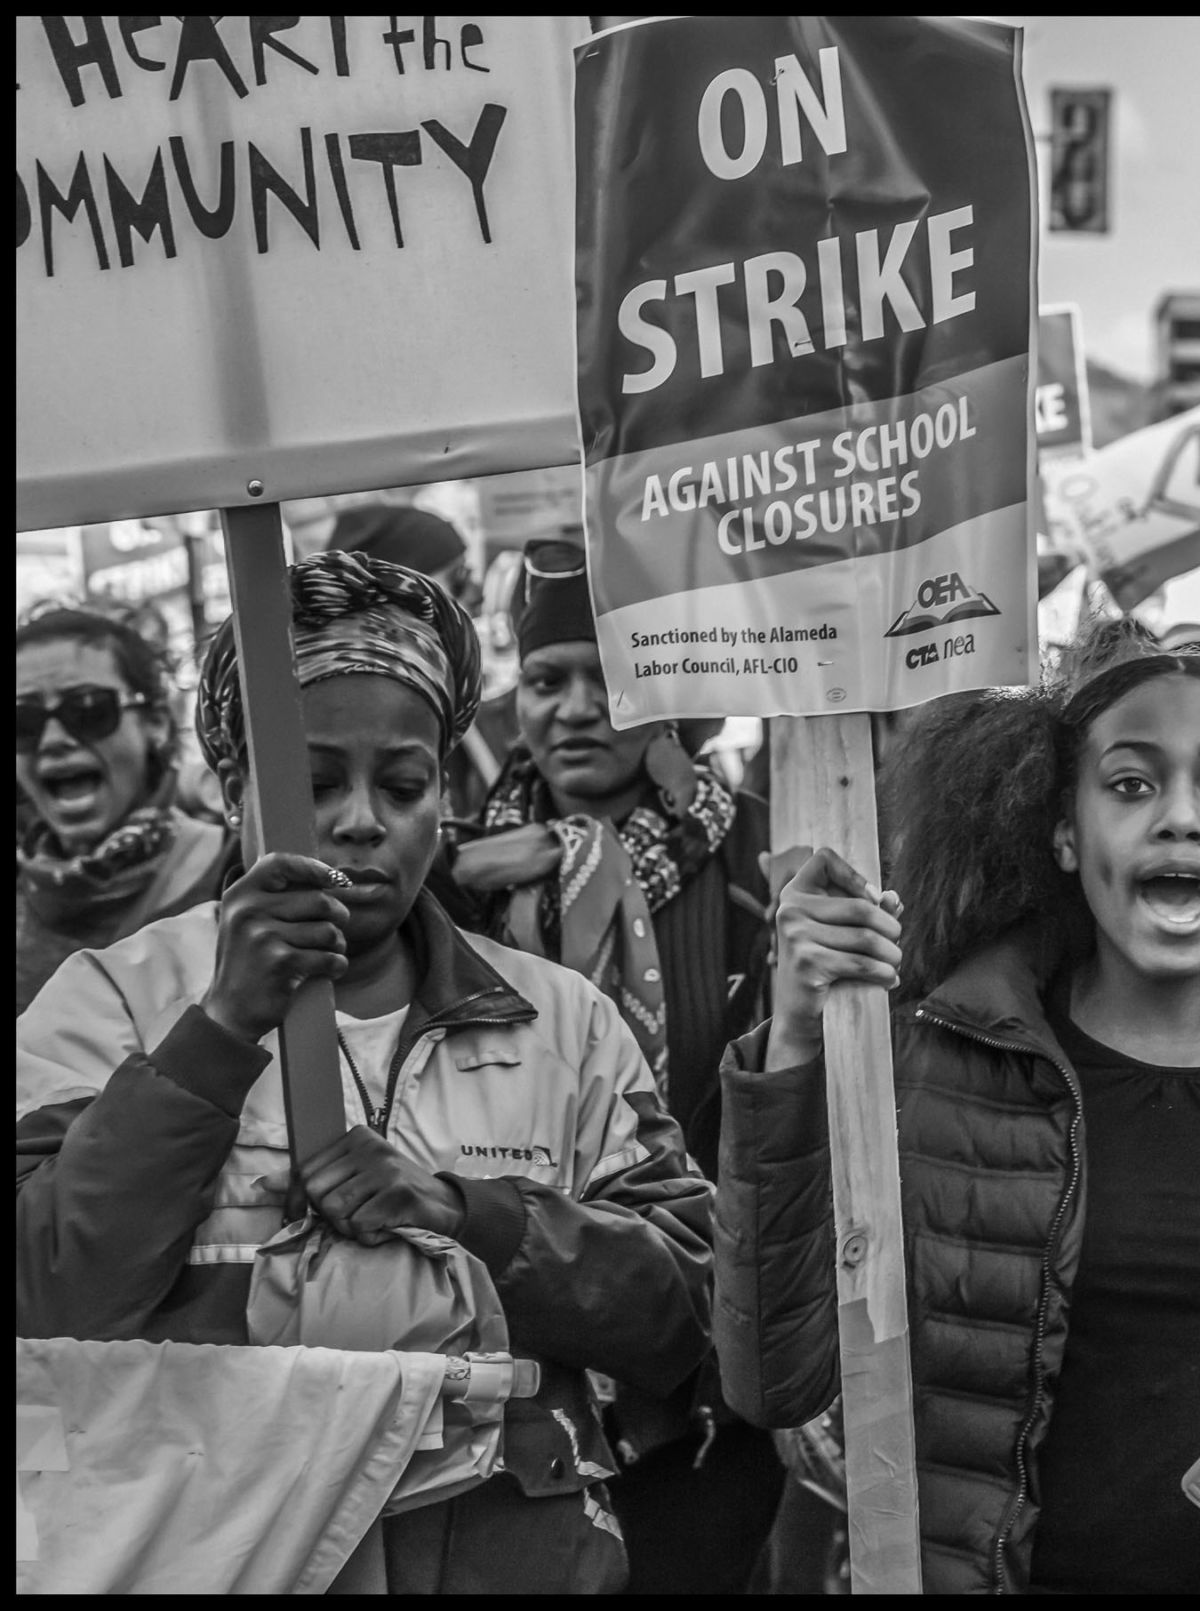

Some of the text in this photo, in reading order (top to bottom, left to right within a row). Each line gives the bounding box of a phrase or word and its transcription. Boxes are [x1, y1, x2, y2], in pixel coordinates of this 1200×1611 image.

[382, 16, 491, 76] the
[698, 46, 848, 181] ON
[617, 204, 977, 395] STRIKE
[641, 438, 821, 522] AGAINST
[832, 395, 977, 479] SCHOOL
[717, 469, 922, 556] CLOSURES
[917, 571, 972, 609] OEA
[631, 623, 838, 648] Sanctioned by the Alameda
[905, 633, 976, 670] CTA nea
[634, 656, 798, 679] Labor Council, AFL-CIO
[460, 1144, 533, 1161] UNITED
